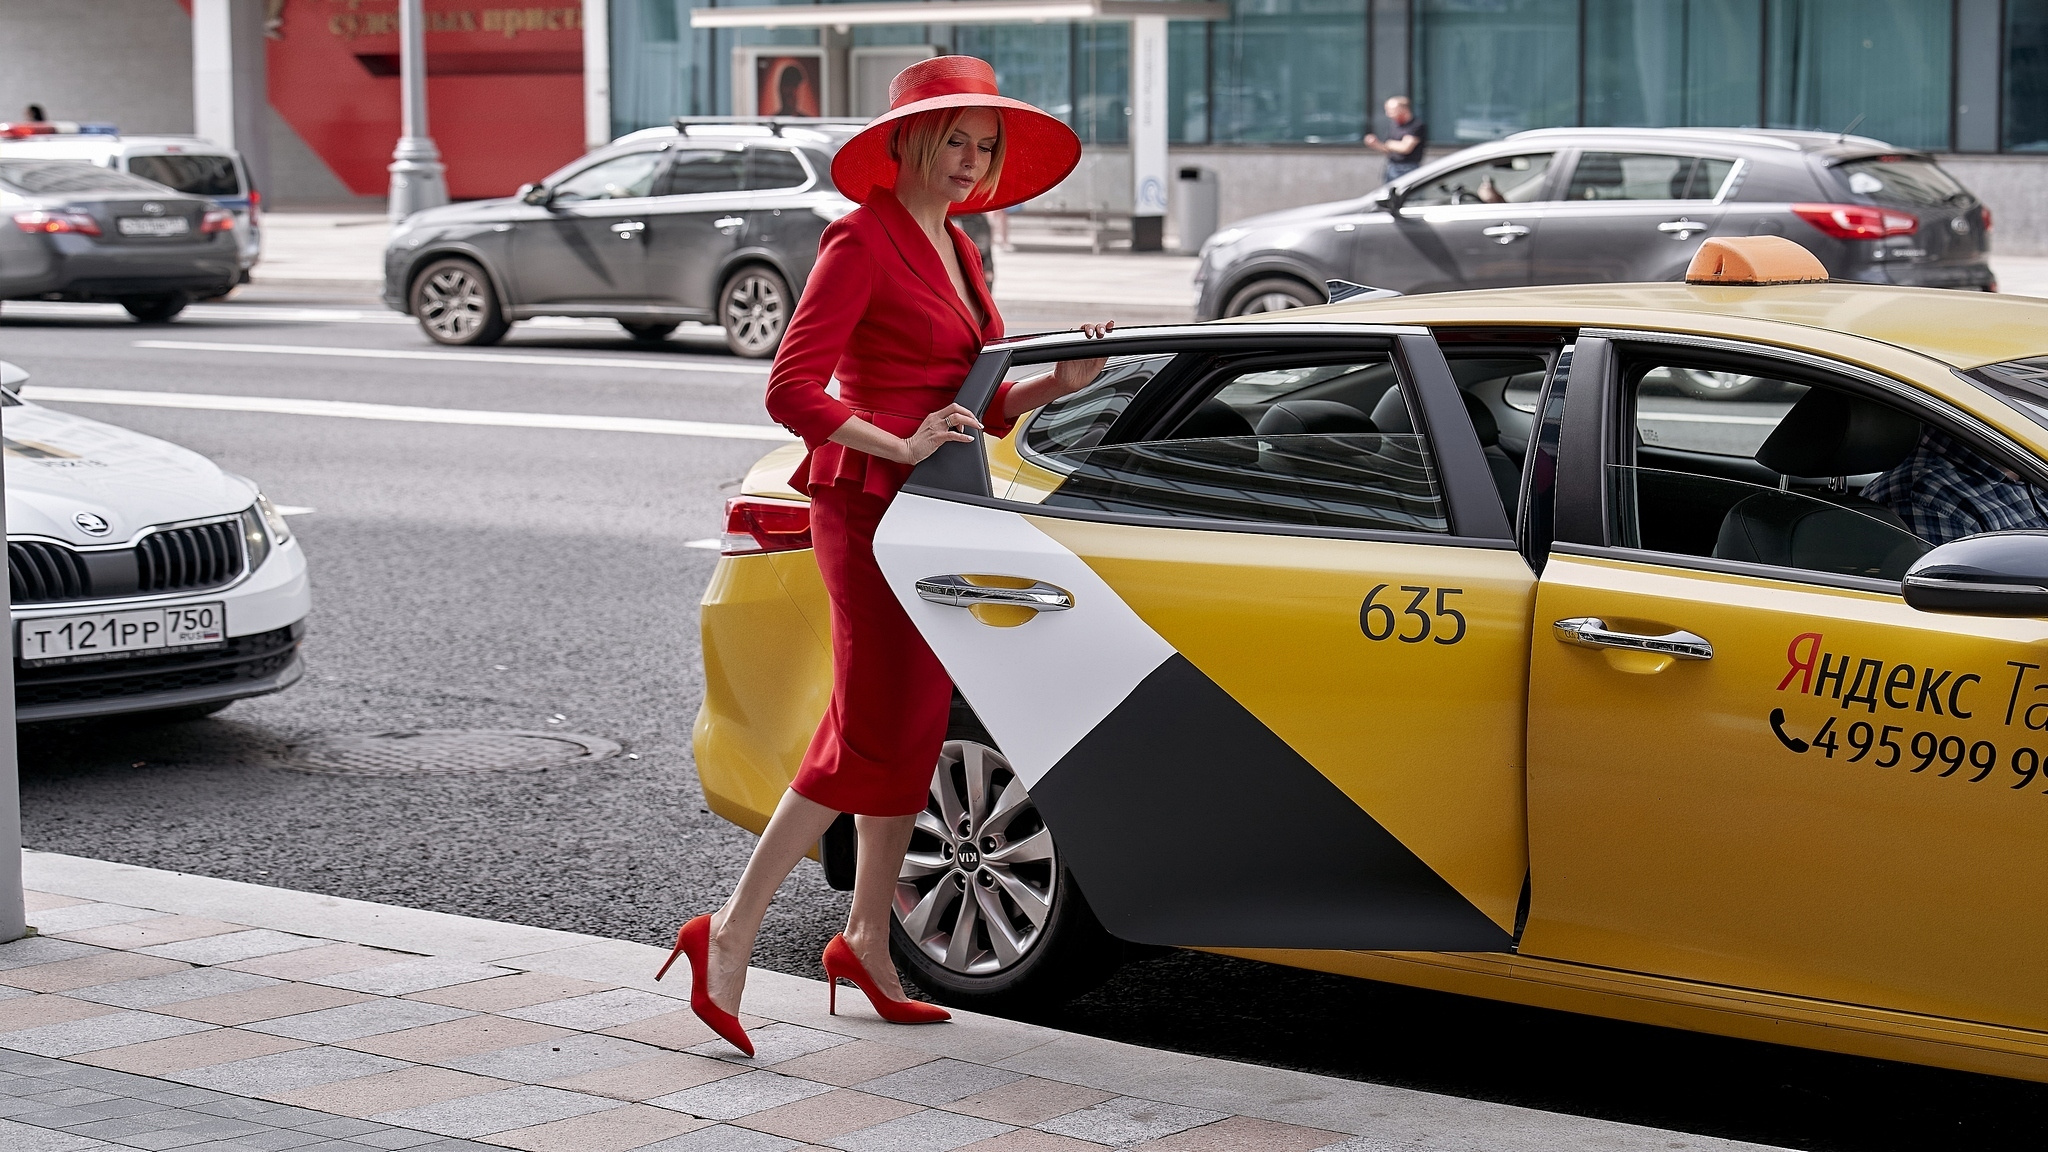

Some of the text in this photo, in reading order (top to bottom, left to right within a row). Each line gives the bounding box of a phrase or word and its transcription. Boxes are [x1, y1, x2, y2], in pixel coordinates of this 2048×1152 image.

[482, 8, 583, 37] прист
[167, 608, 214, 633] 750
[1359, 583, 1467, 645] 635
[1776, 632, 1982, 720] Яндекс
[2009, 747, 2048, 795] 9
[958, 852, 978, 863] KIA
